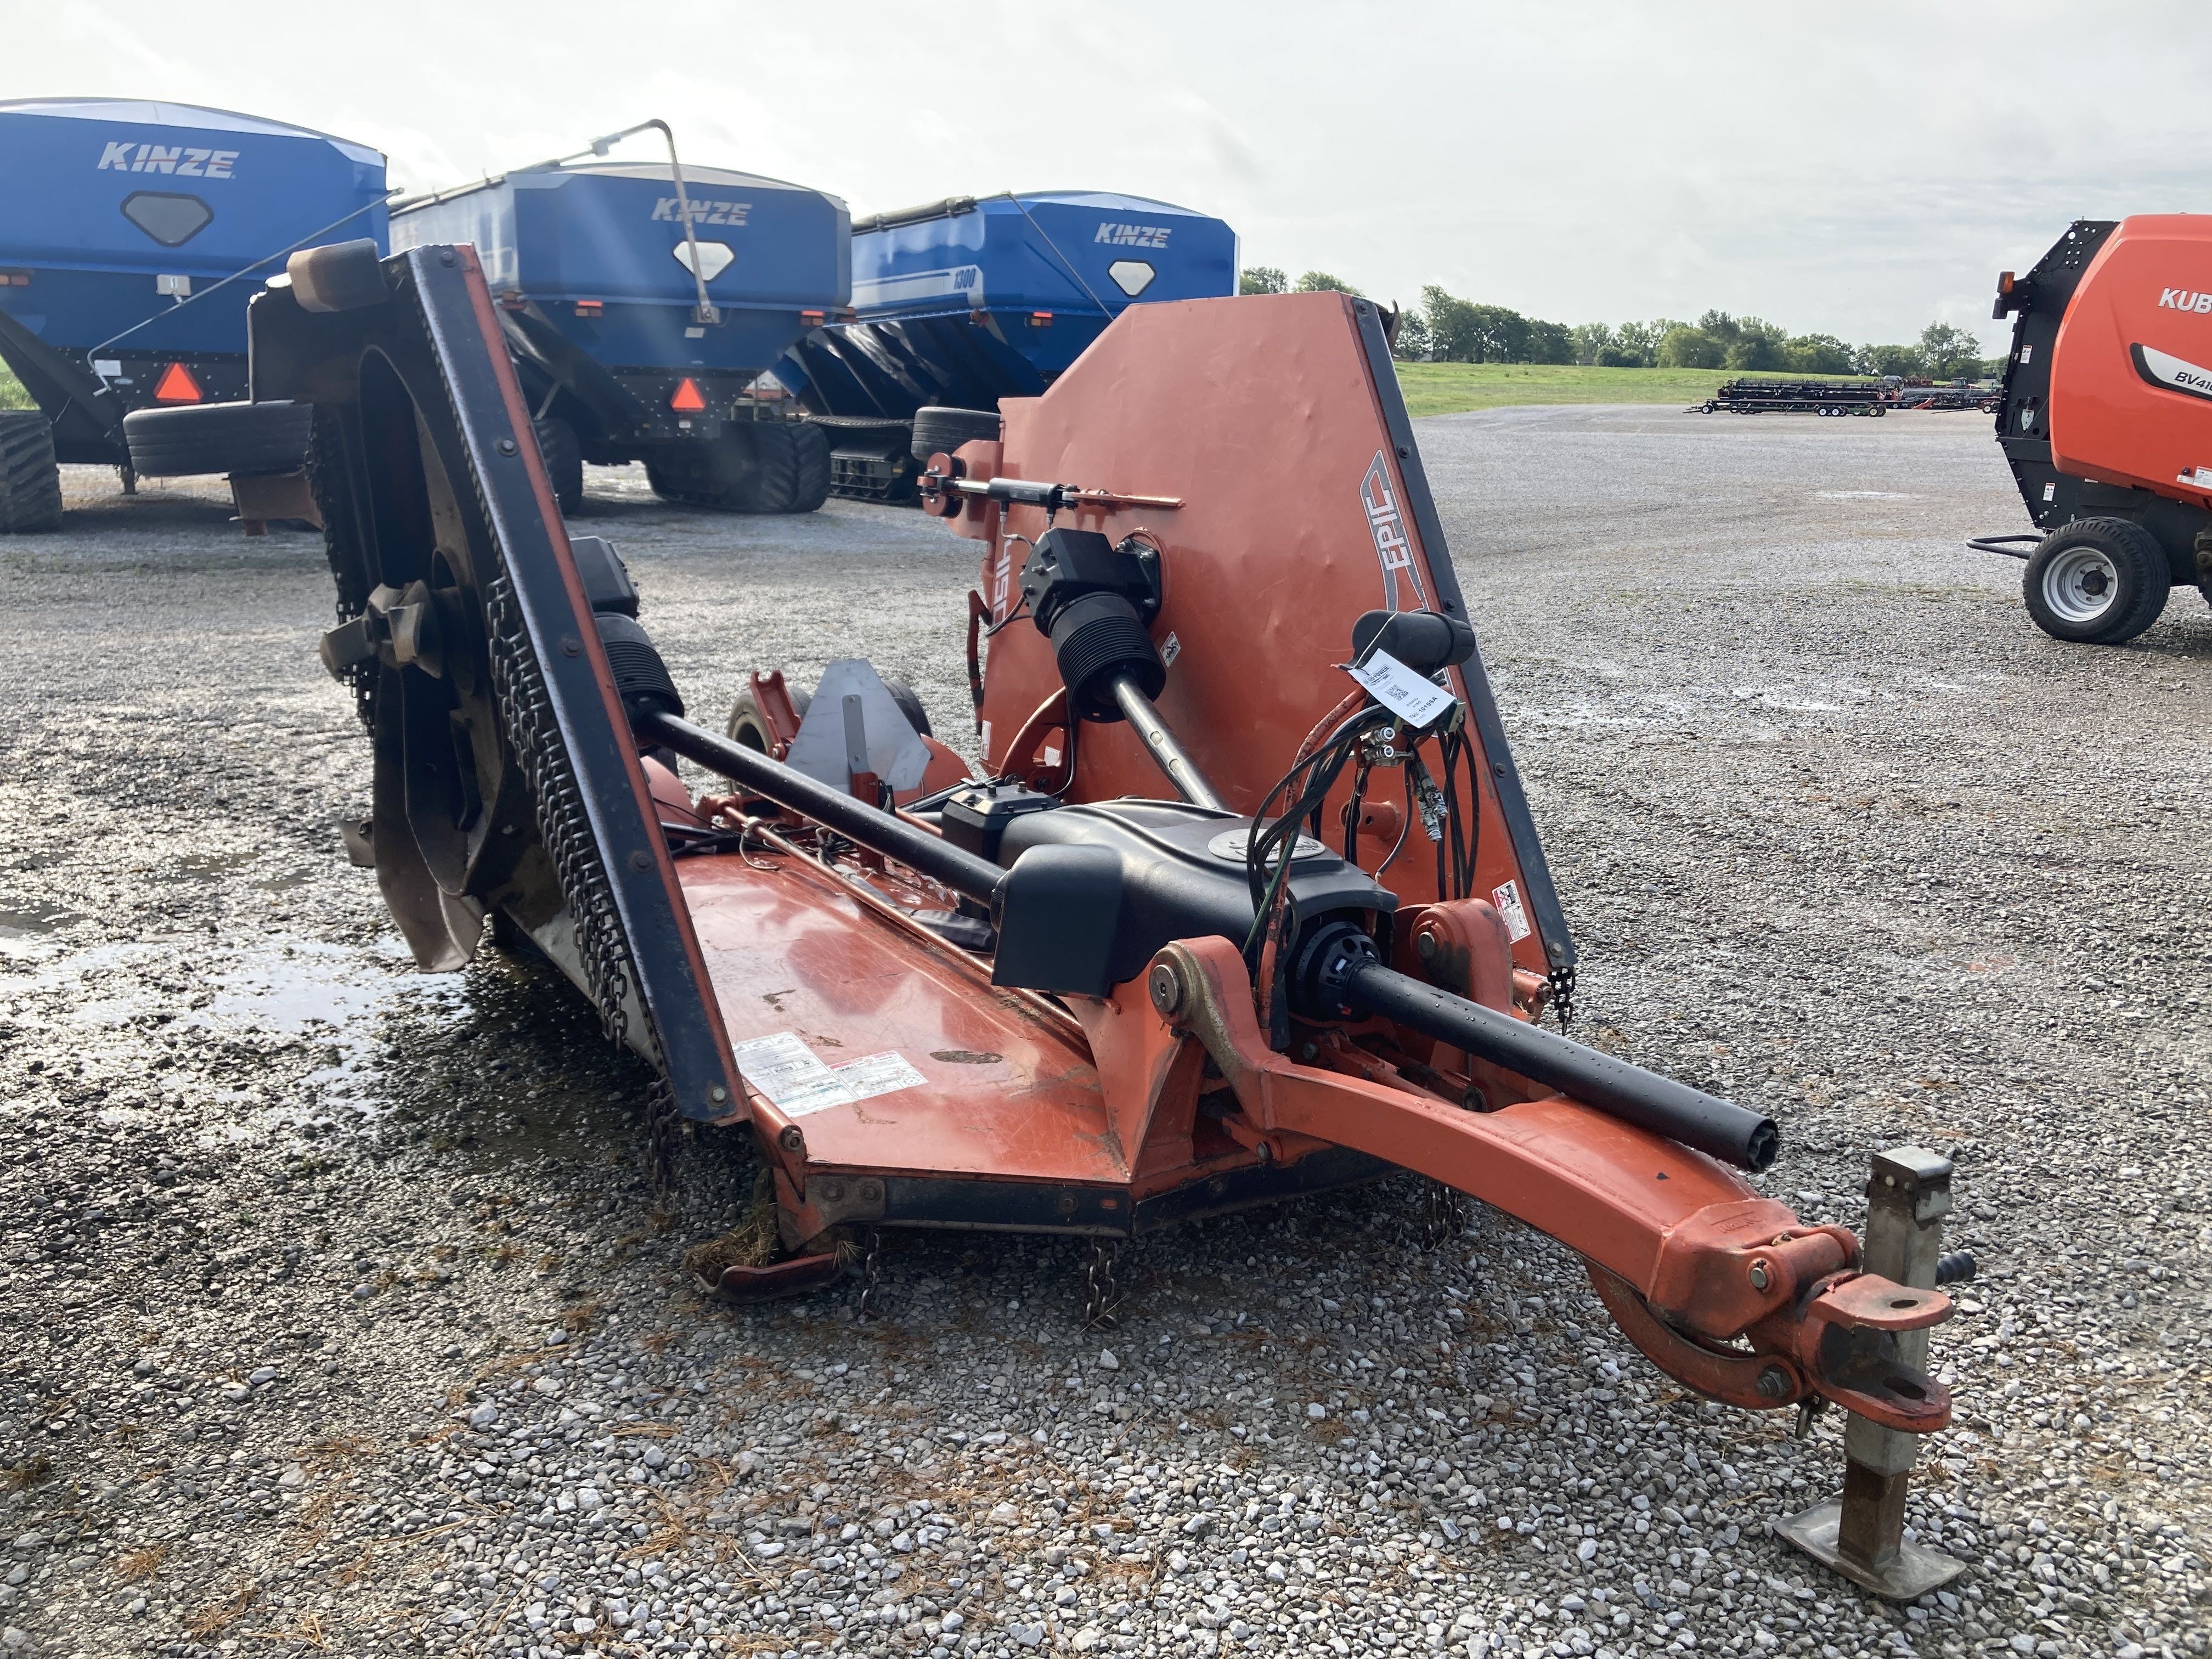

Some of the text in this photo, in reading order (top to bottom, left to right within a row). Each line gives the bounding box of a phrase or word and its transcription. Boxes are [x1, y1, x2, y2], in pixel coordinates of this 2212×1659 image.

[97, 141, 240, 179] KINZE
[1094, 222, 1172, 249] KINZE
[953, 268, 976, 290] 1300
[1365, 488, 1412, 571] EPIC
